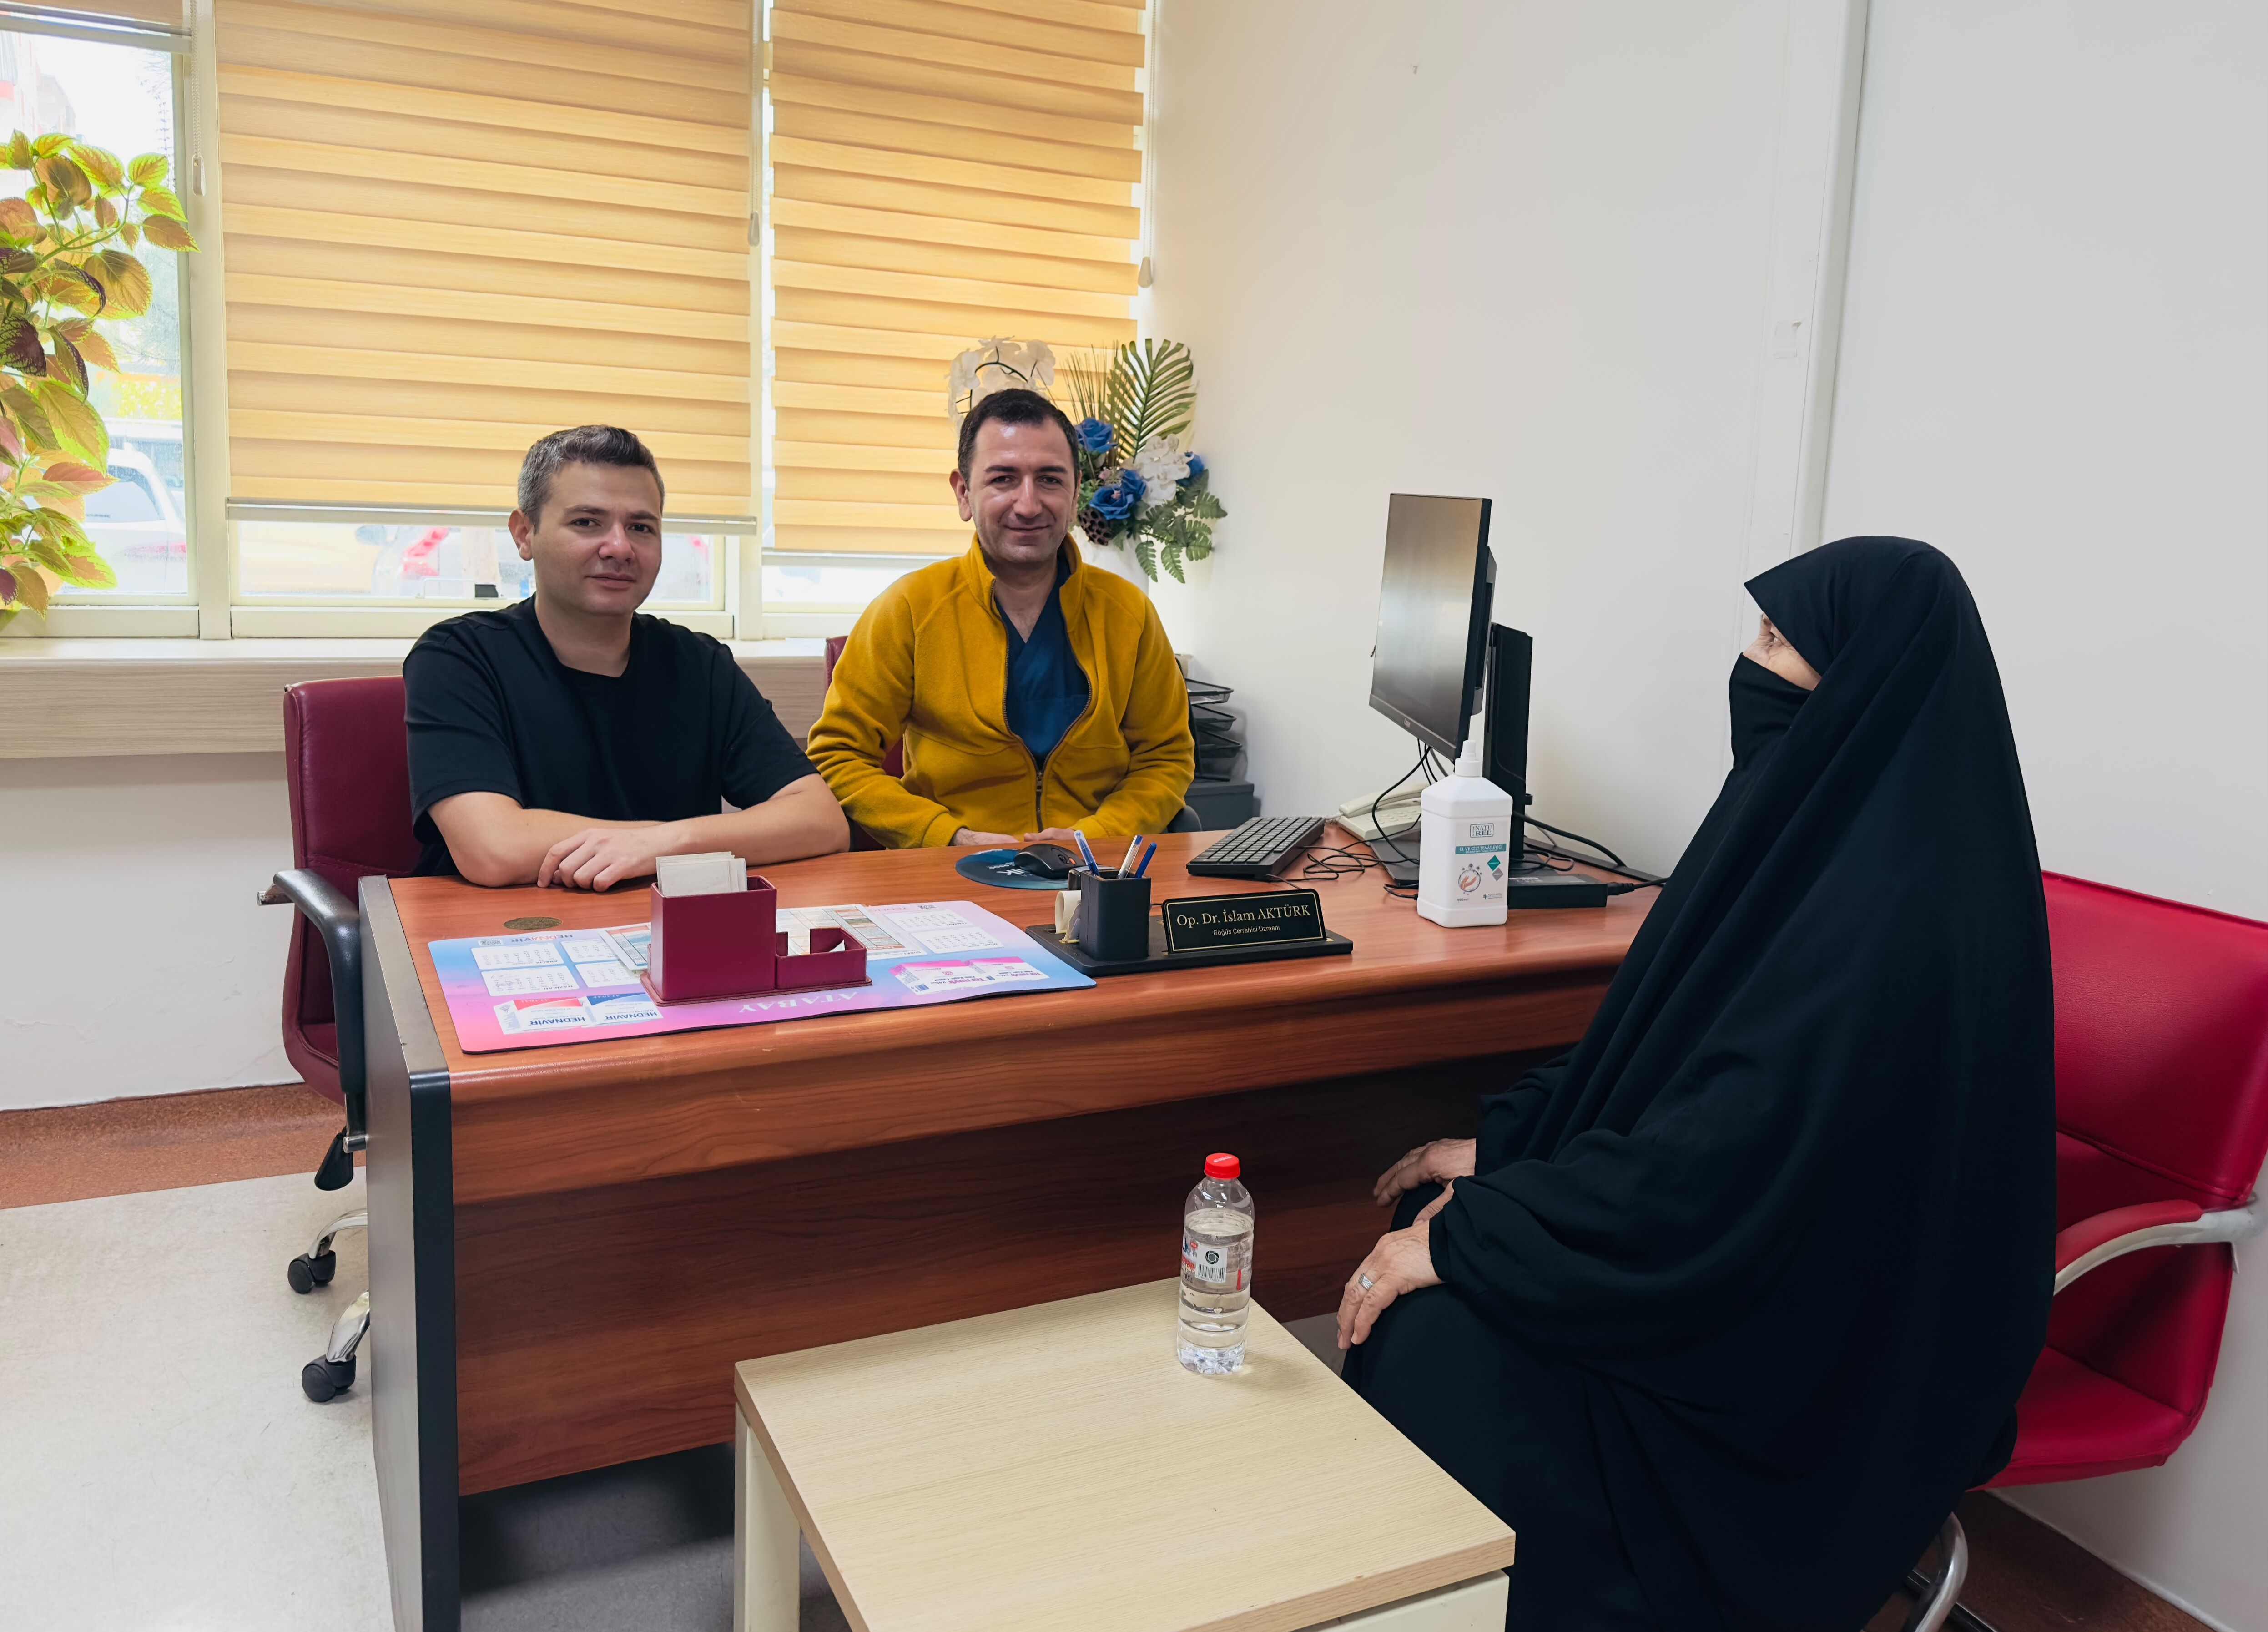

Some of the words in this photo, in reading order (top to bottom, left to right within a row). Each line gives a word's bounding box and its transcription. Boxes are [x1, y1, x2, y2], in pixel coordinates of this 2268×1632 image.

[1177, 915, 1199, 928] Op.
[1202, 913, 1220, 924] Dr.
[1223, 909, 1255, 922] İslam
[1257, 904, 1310, 920] AKTÜRK
[1213, 928, 1232, 936] Göğüs
[739, 991, 858, 1013] ATABAY
